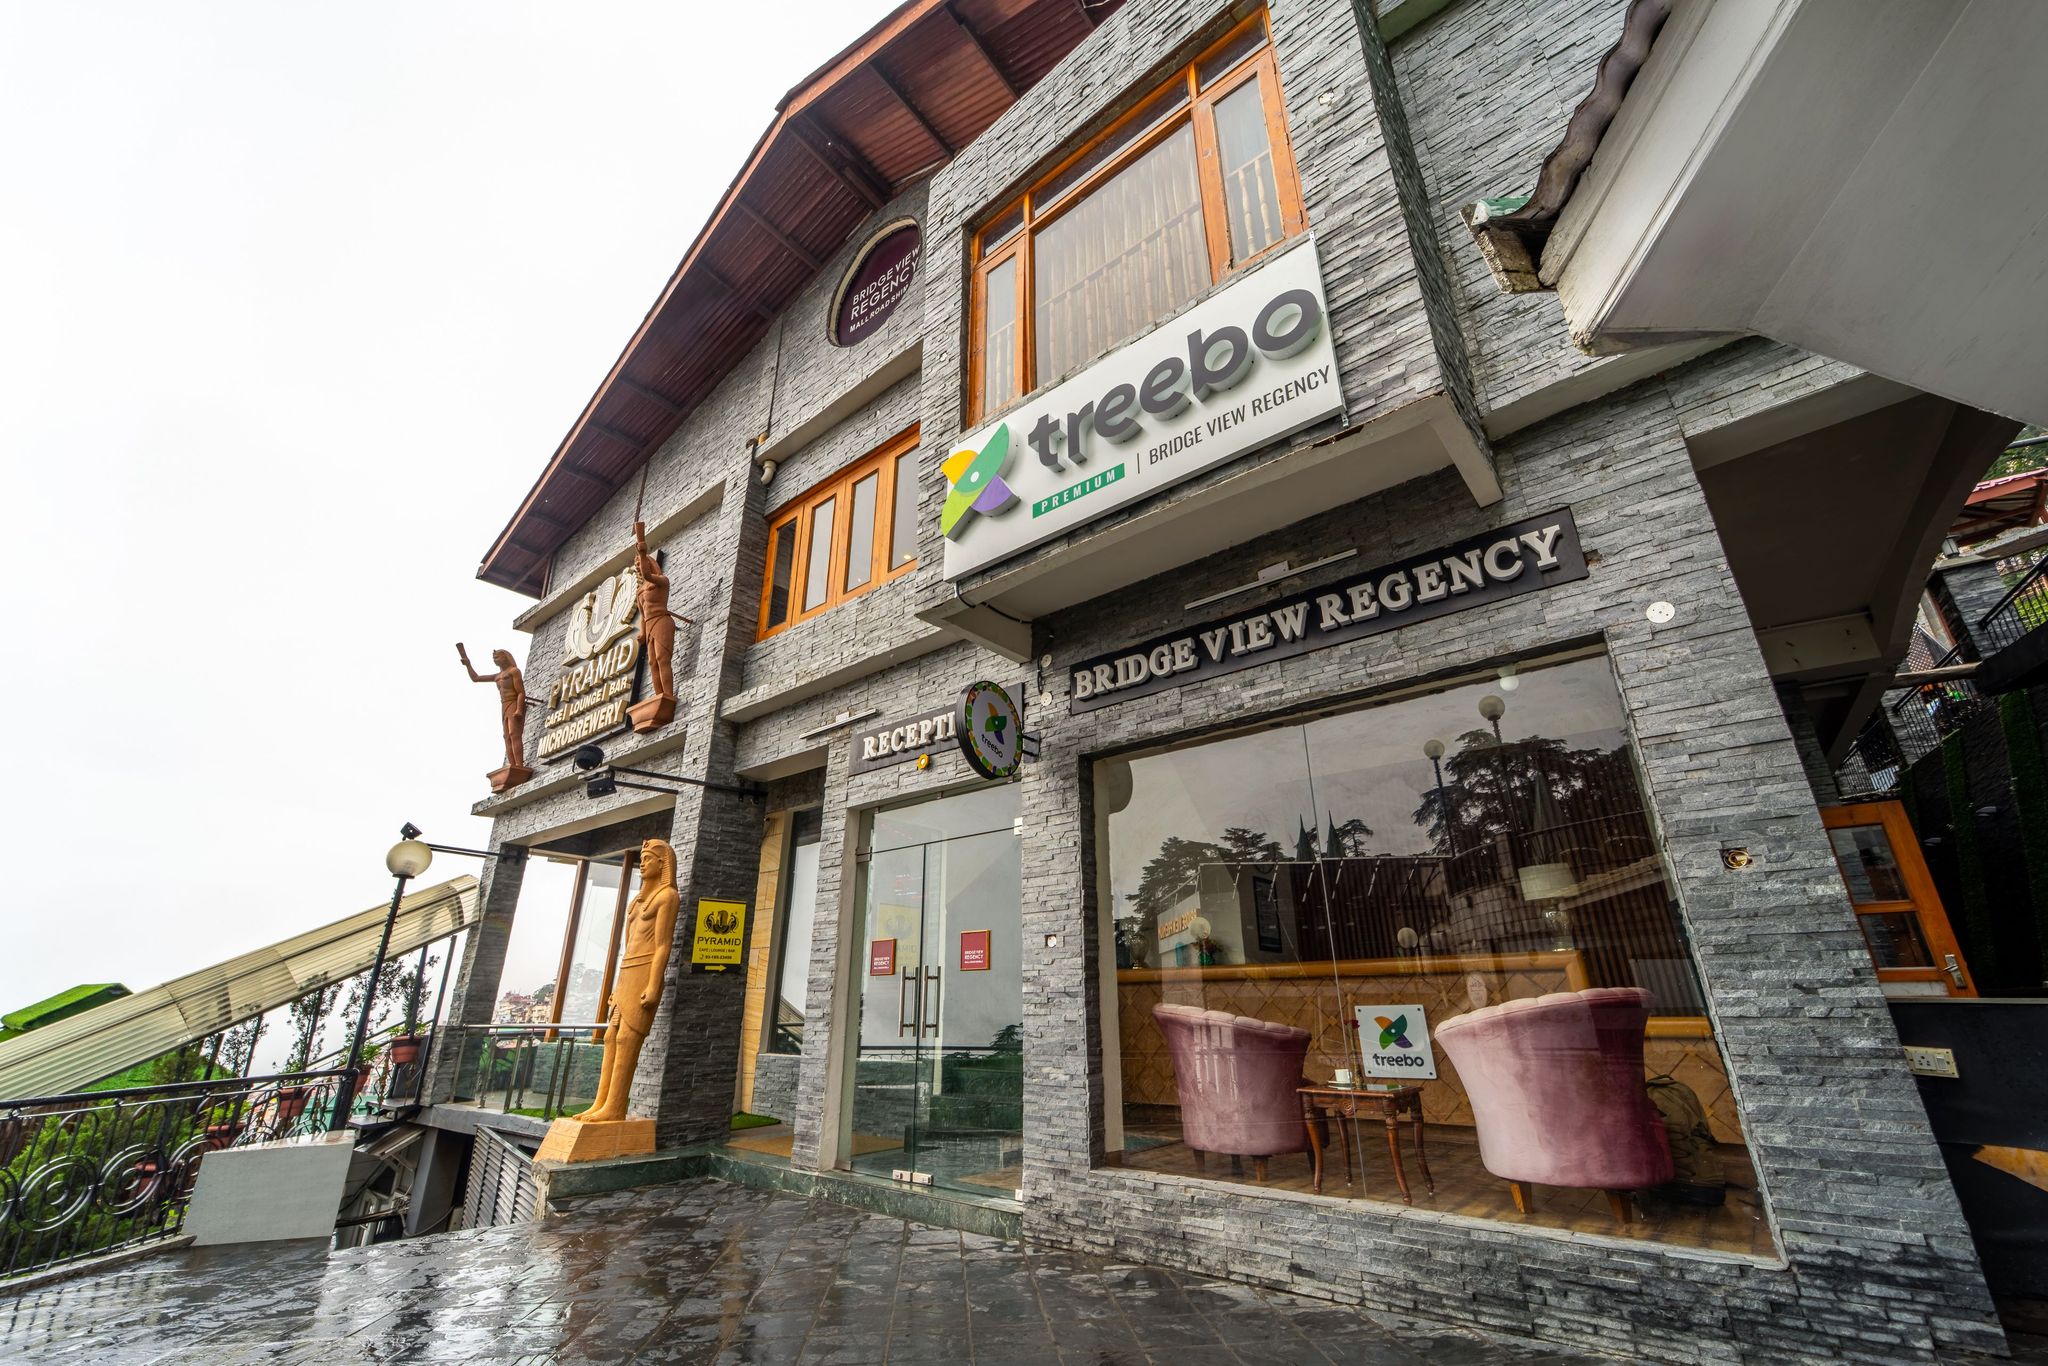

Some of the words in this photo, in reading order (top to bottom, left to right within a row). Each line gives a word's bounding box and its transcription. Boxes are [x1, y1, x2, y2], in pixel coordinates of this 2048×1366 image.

[850, 257, 919, 321] REGENCY
[852, 268, 894, 306] BRIDGE
[895, 244, 920, 272] VIEW
[849, 316, 869, 333] MALL
[869, 300, 890, 319] ROAD
[1028, 289, 1322, 472] treebo
[1149, 425, 1203, 466] BRIDGE
[1206, 404, 1247, 437] VIEW
[1251, 364, 1331, 418] REGENCY
[1041, 468, 1116, 513] PREMIUM
[1073, 636, 1199, 701] BRIDGE
[1200, 600, 1308, 662] VIEW
[1317, 524, 1561, 632] REGENCY
[548, 639, 638, 709] PYRAMID
[569, 689, 603, 717] LOUNGE
[608, 676, 629, 696] BAR
[536, 699, 625, 758] MICROBREWERY
[862, 711, 957, 760] RECEPTI
[981, 733, 1004, 759] treebo
[697, 936, 742, 946] PYRAMID
[1372, 1053, 1425, 1067] treebo
